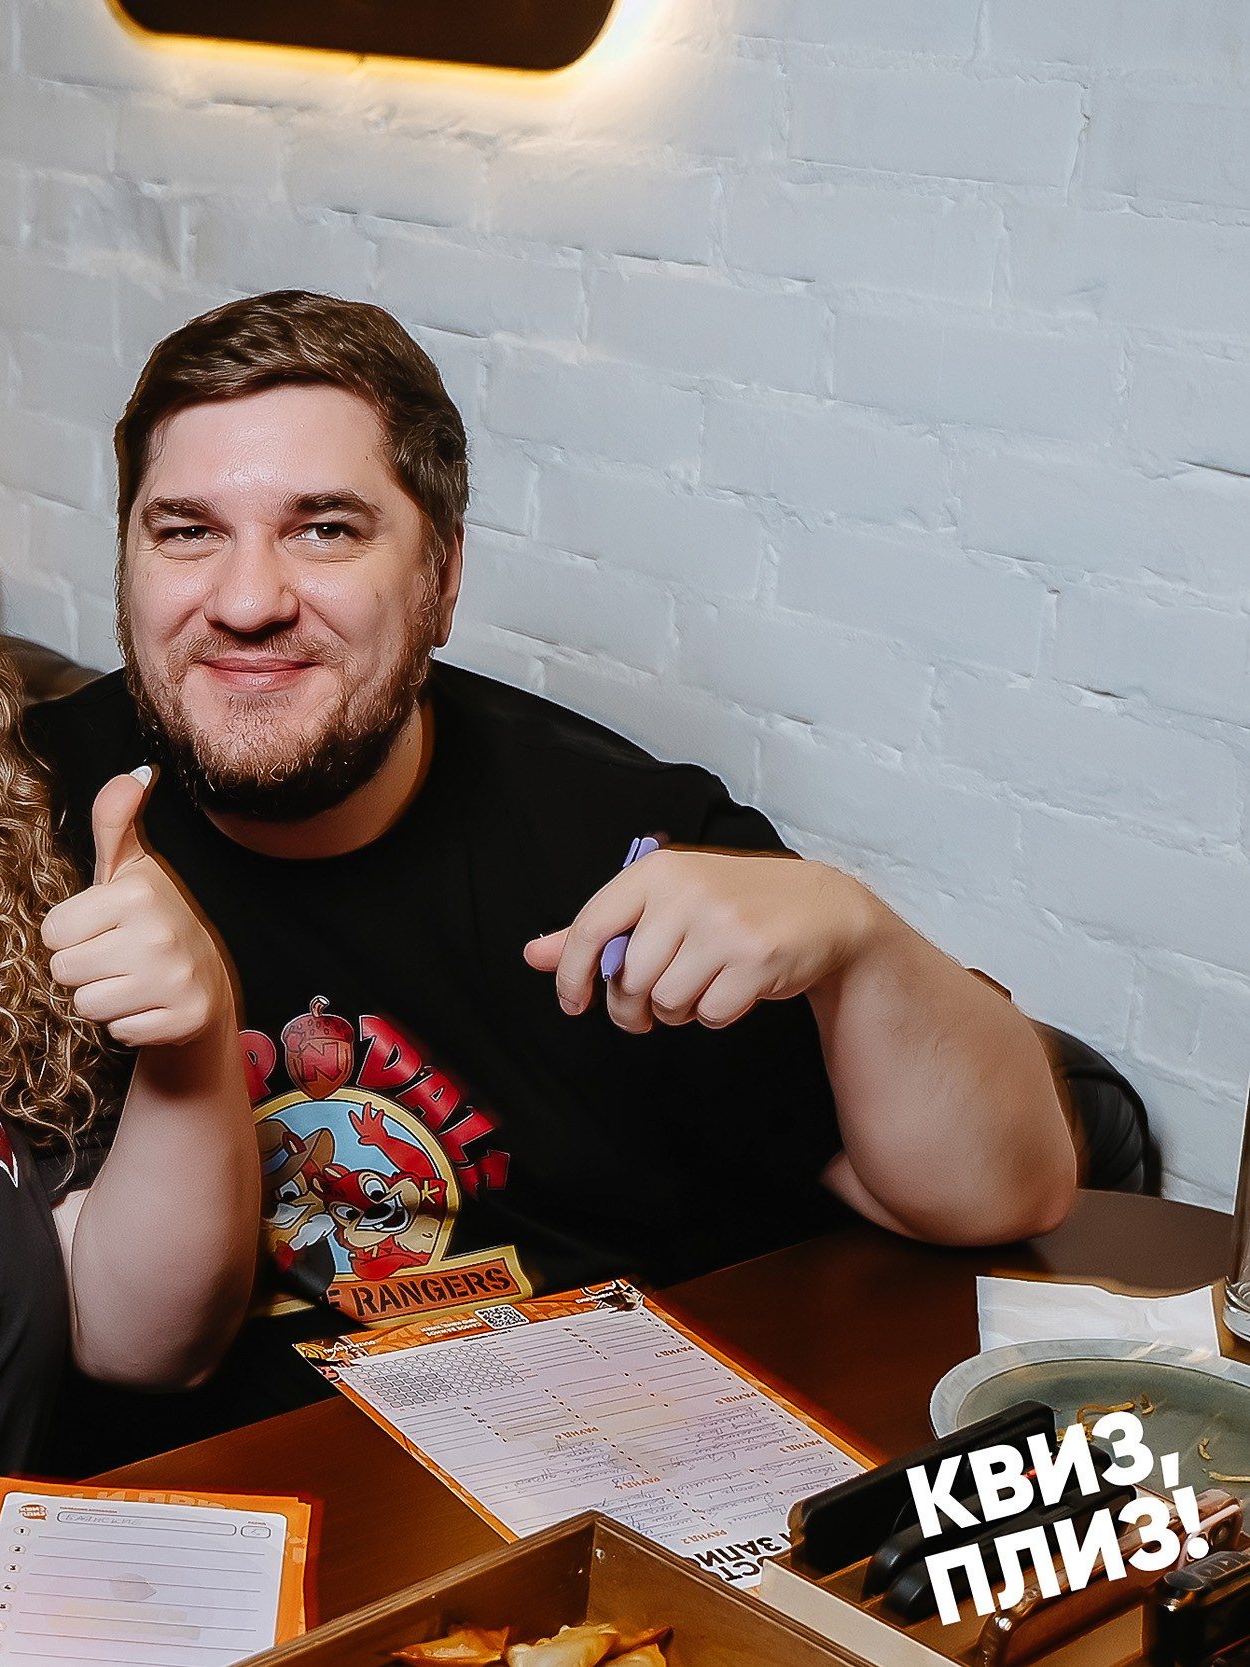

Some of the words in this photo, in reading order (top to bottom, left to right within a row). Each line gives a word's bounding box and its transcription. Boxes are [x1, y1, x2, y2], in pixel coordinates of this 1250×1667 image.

[351, 1267, 511, 1317] RANGERS
[662, 1345, 695, 1357] РАУНД
[723, 1391, 758, 1404] РАУНД
[561, 1426, 599, 1439] РАУНД
[788, 1438, 823, 1451] РАУНД
[623, 1475, 662, 1489] РАУНД
[690, 1529, 728, 1544] РАУНД
